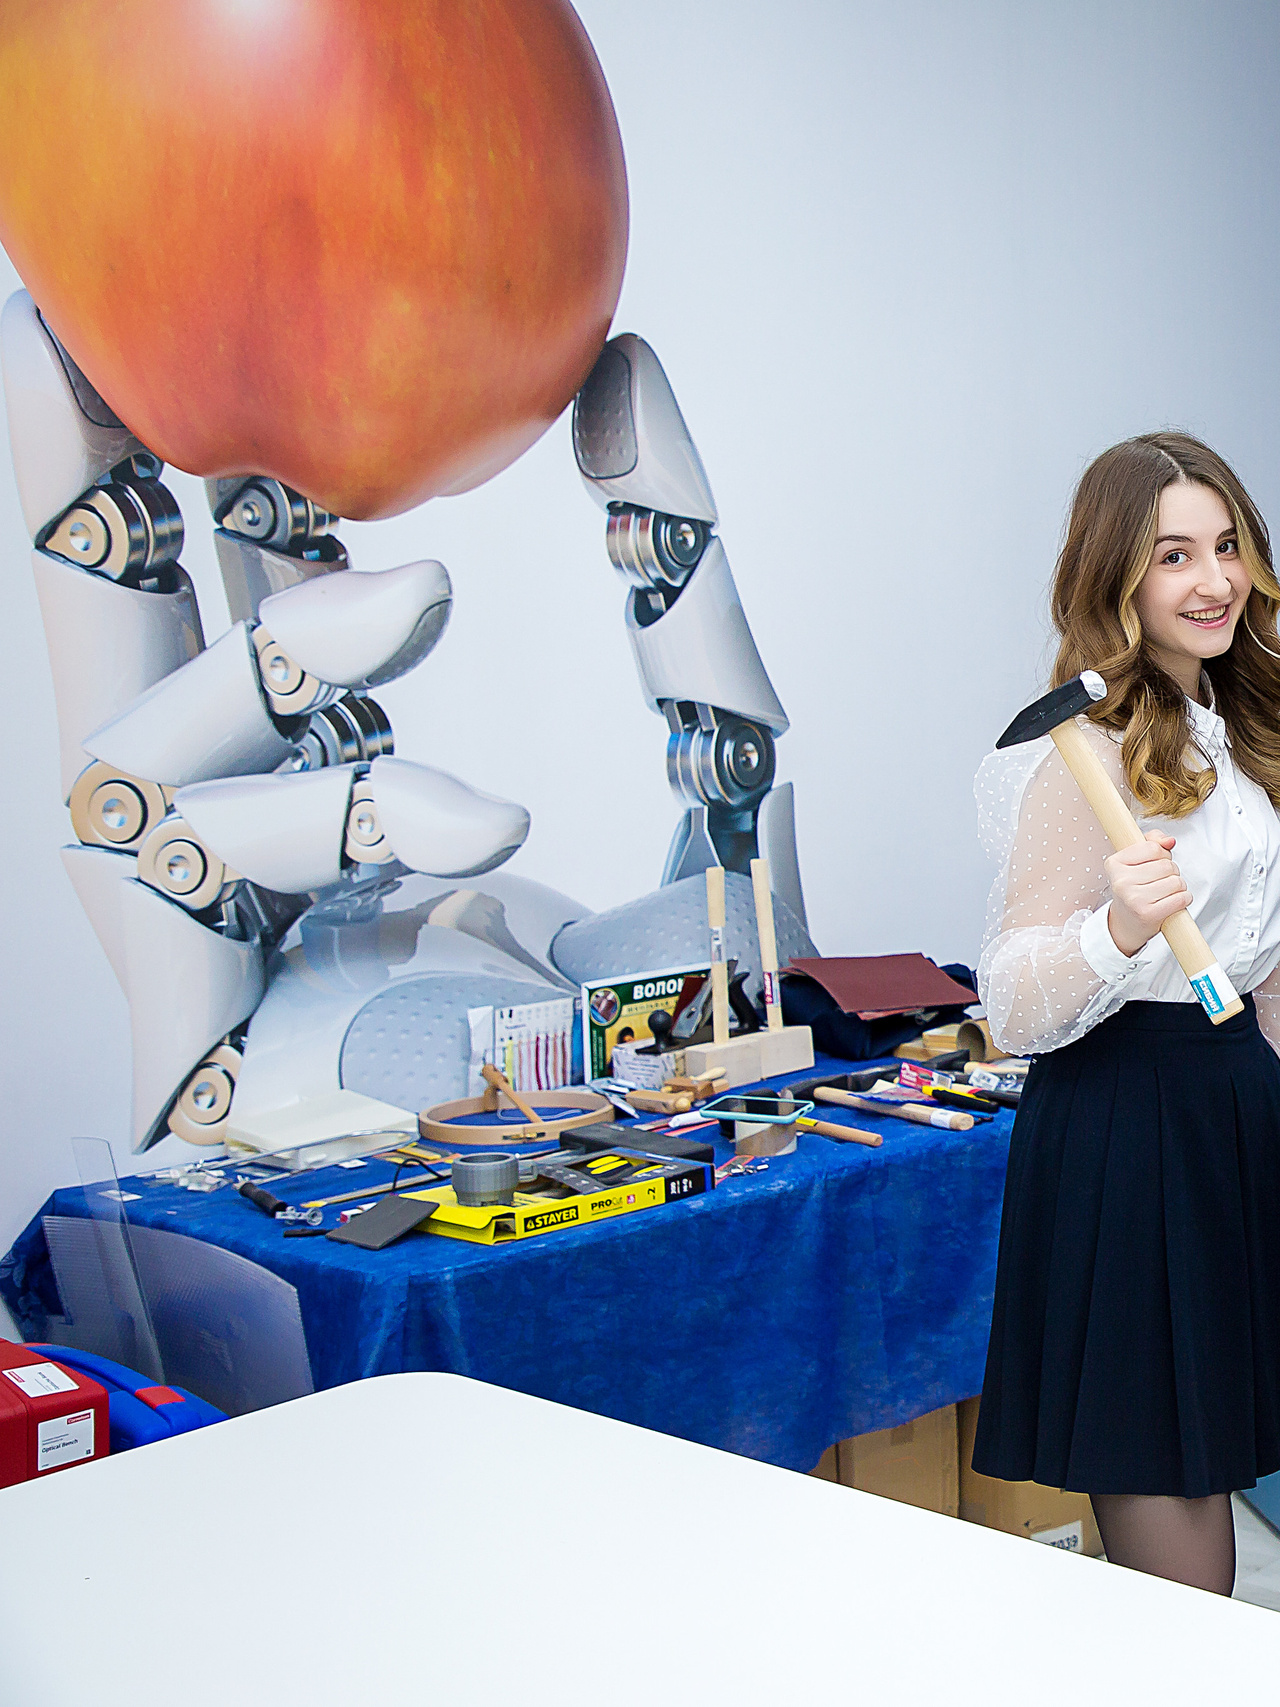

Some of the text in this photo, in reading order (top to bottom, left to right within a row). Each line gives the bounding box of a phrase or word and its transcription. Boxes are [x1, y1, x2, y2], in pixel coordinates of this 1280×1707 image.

[534, 1209, 577, 1228] STAYER
[42, 1443, 60, 1453] Optical
[62, 1439, 78, 1448] Bench
